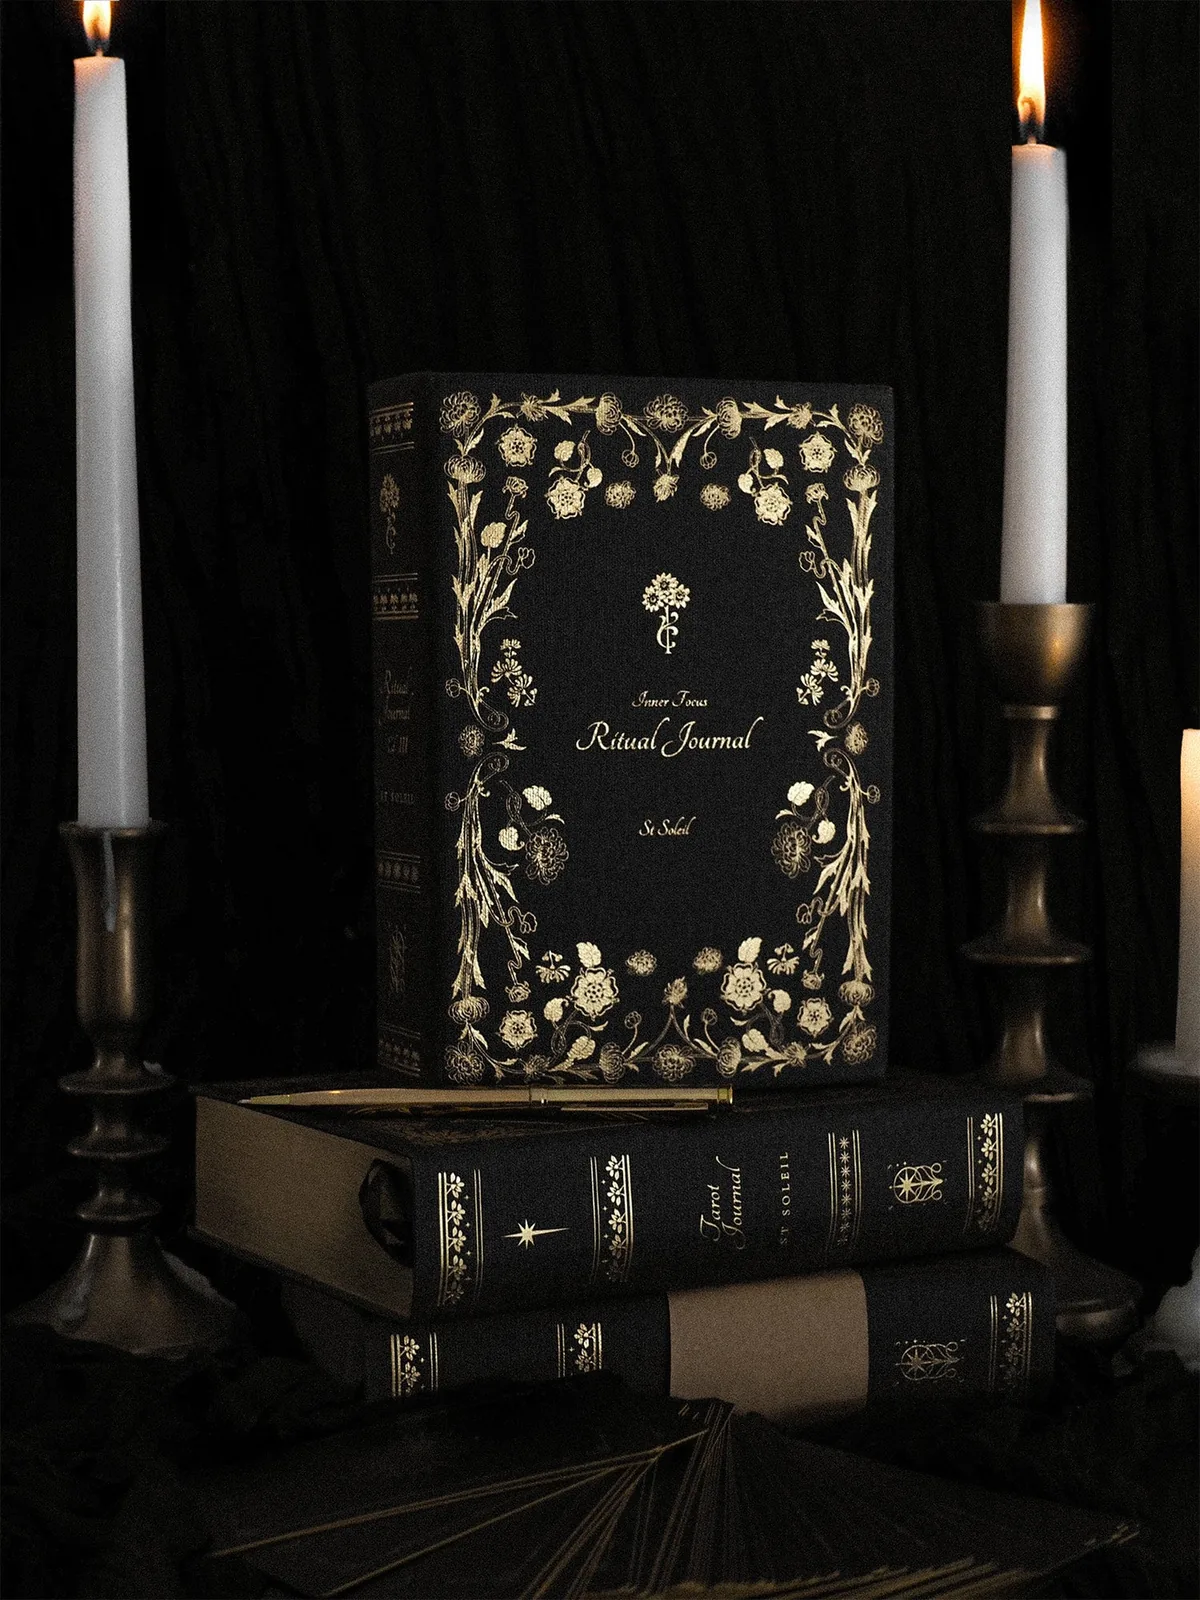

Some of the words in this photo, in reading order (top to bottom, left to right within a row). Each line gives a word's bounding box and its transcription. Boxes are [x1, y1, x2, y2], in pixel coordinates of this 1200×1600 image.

[631, 690, 670, 708] Inner
[671, 690, 708, 707] Focus
[576, 716, 671, 751] Ritual
[661, 716, 764, 758] Journal
[639, 819, 655, 836] St
[657, 816, 697, 836] Soleil
[715, 1155, 746, 1250] Journal
[780, 1151, 791, 1217] SOLEIL
[700, 1184, 720, 1242] Tarot
[780, 1226, 790, 1245] ST
